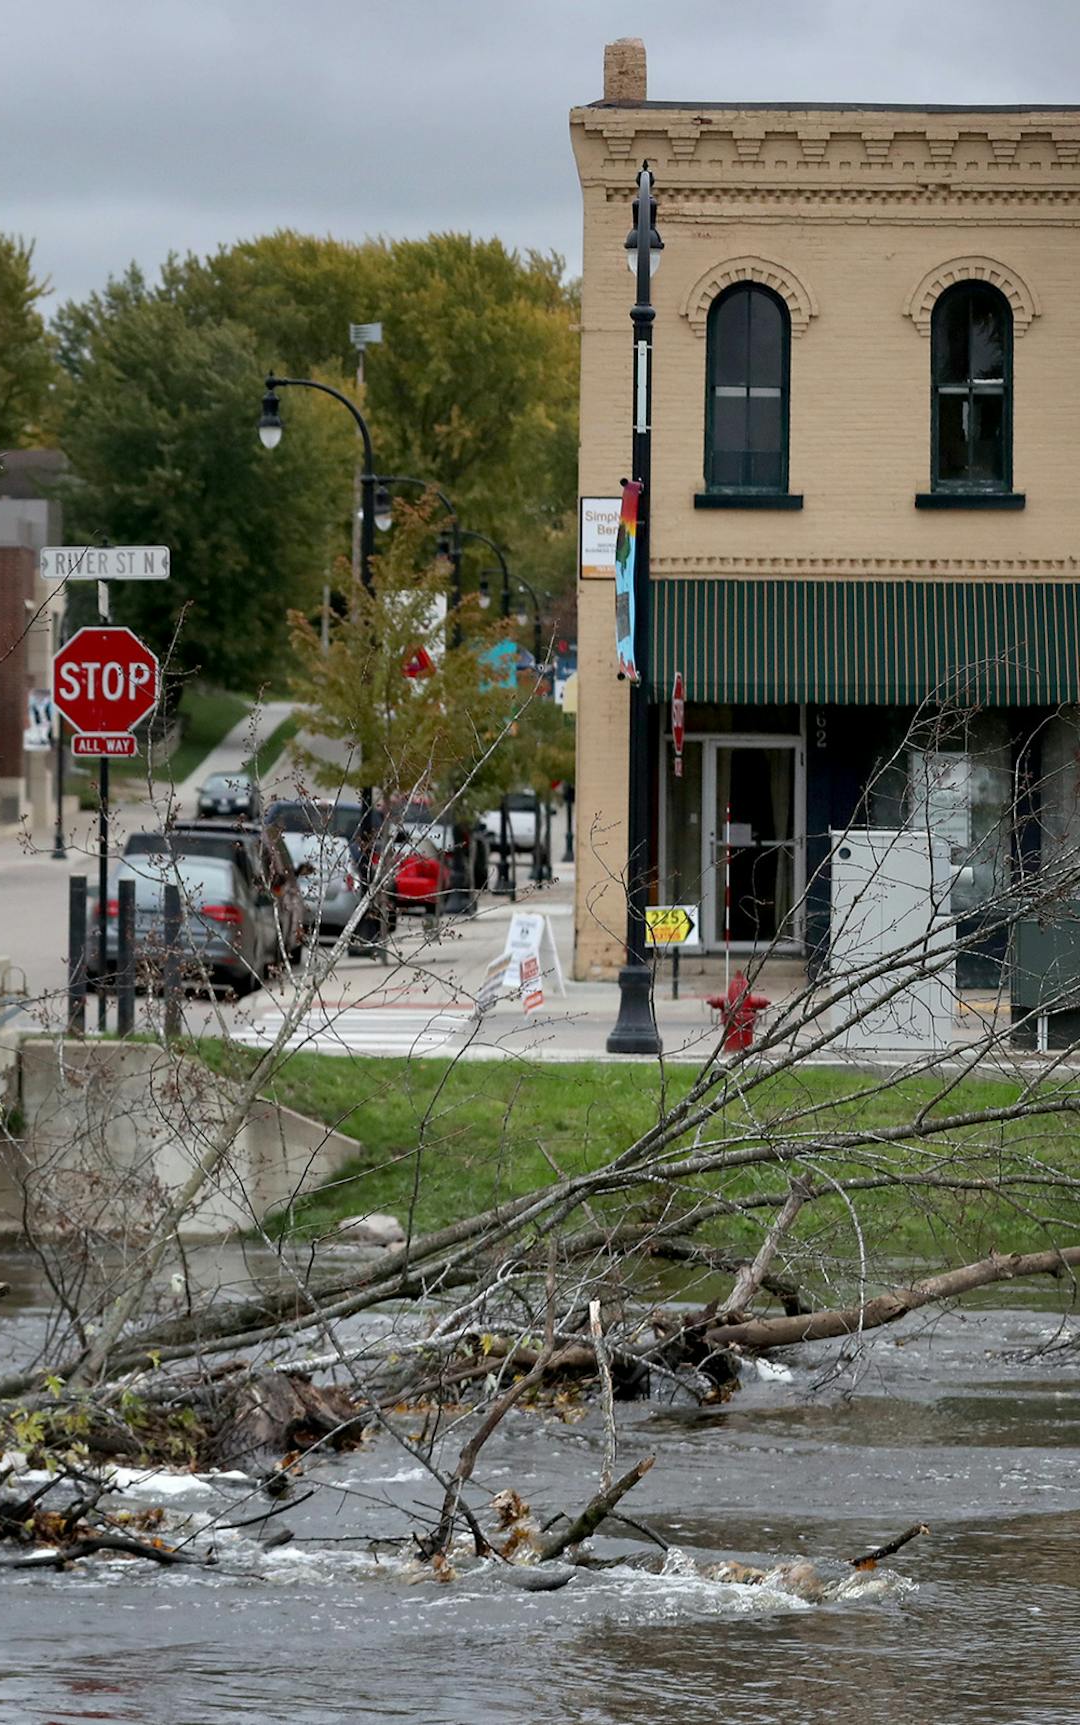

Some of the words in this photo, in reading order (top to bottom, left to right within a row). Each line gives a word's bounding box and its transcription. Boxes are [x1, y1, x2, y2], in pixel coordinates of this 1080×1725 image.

[55, 551, 109, 575] RIVER
[116, 551, 136, 574] ST
[144, 551, 155, 574] N
[59, 661, 151, 701] STOP
[78, 739, 101, 753] ALL
[106, 739, 131, 753] WAY
